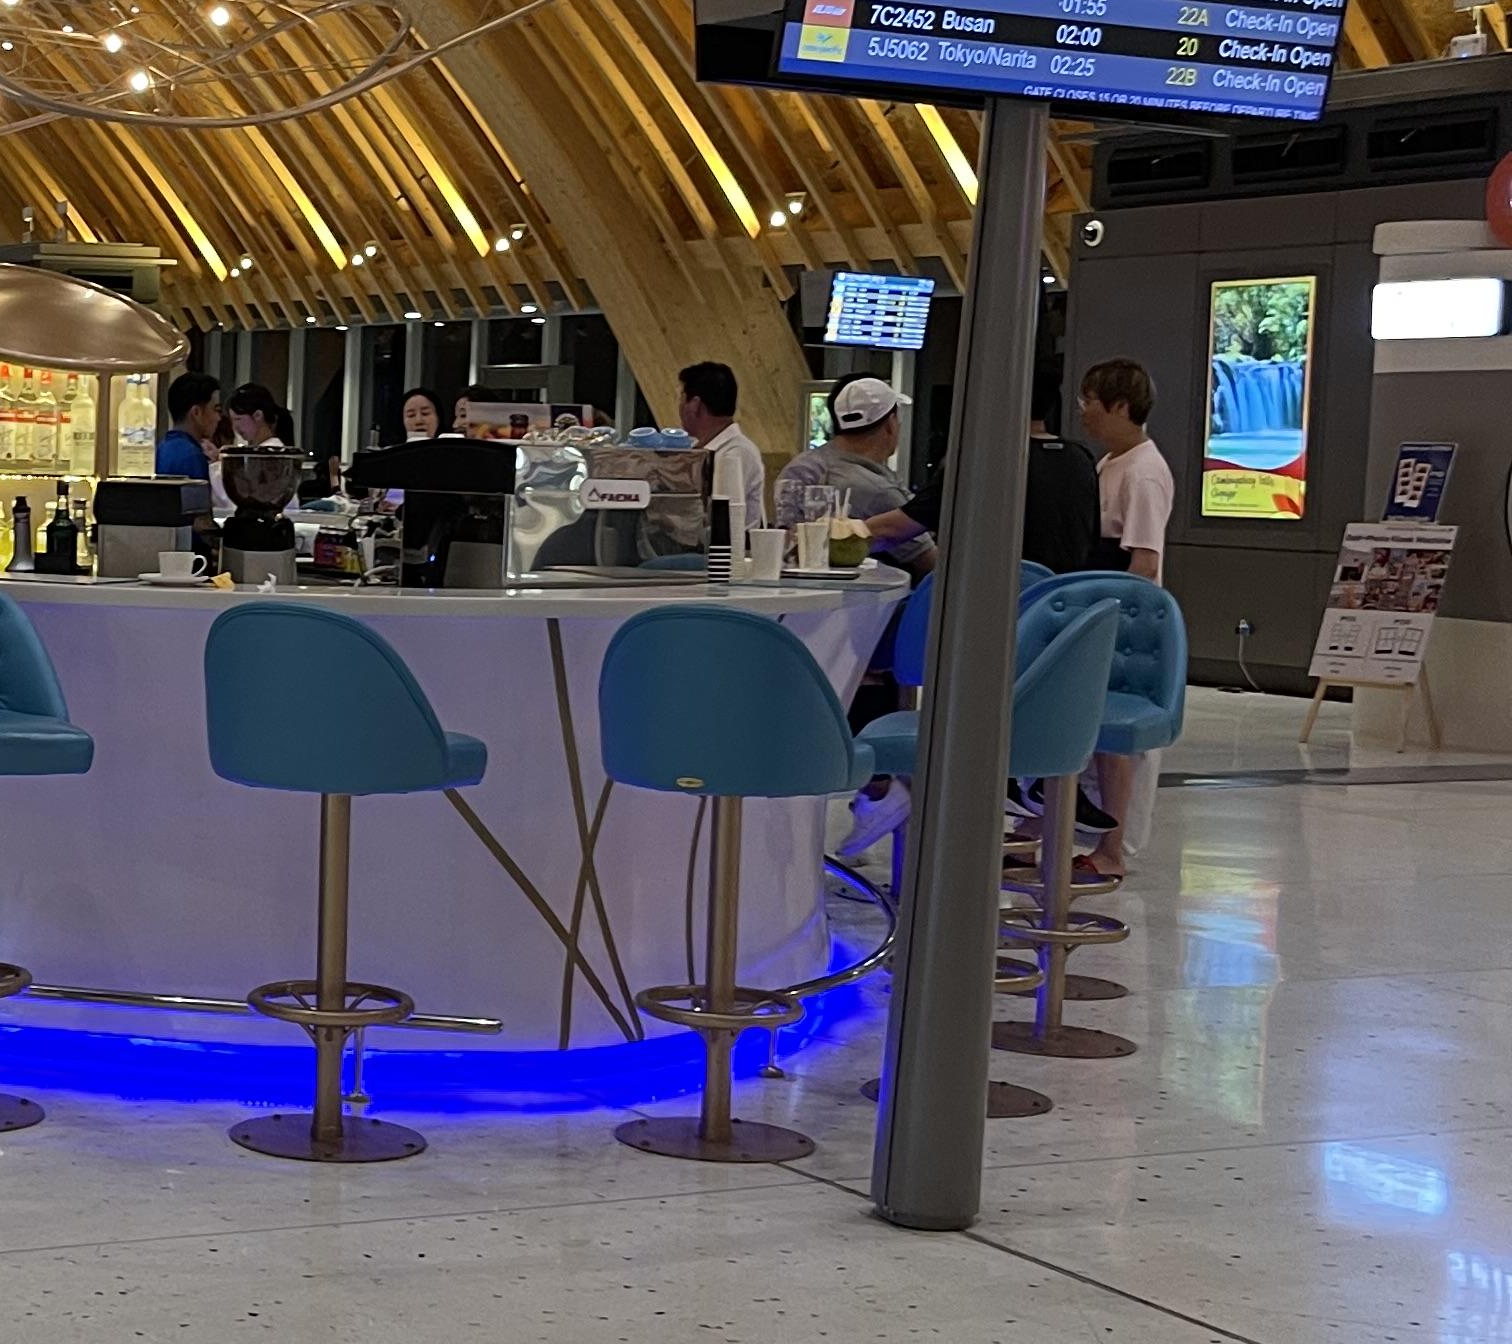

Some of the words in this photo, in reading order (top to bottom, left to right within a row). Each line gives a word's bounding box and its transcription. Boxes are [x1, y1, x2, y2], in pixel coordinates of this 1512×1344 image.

[870, 4, 935, 30] 7C2452
[942, 11, 996, 34] Busan
[1055, 24, 1102, 48] 02:00
[1176, 36, 1198, 57] 20
[1218, 38, 1287, 63] Check-In
[1289, 47, 1332, 69] Open
[1177, 6, 1209, 28] 22A
[1225, 8, 1293, 33] Check-In
[1295, 18, 1337, 39] Open
[867, 36, 929, 62] 5J5062
[938, 41, 1037, 70] Tokyo/Narita
[1049, 54, 1096, 78] 02:25
[1165, 66, 1197, 88] 22B
[1212, 68, 1281, 93] Check-In
[1283, 77, 1326, 99] Open
